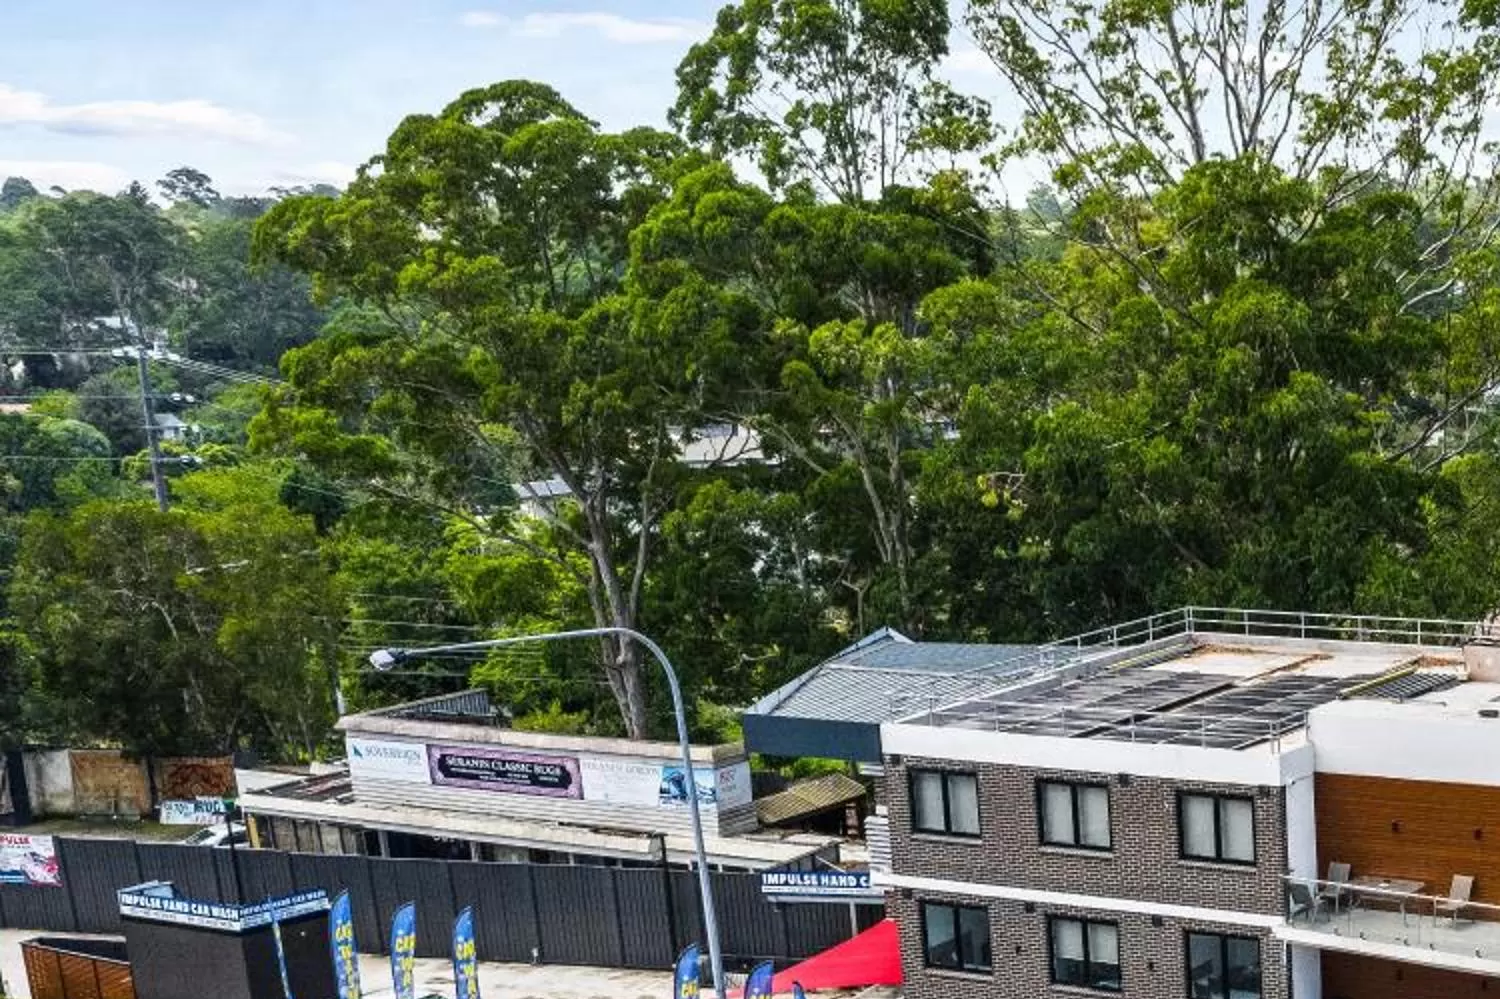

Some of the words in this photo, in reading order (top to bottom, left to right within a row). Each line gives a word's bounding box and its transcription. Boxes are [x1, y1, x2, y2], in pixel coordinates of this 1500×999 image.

[762, 873, 819, 885] IMPULSE
[821, 875, 857, 887] HAND
[191, 903, 209, 917] CAR
[210, 906, 239, 921] WASH
